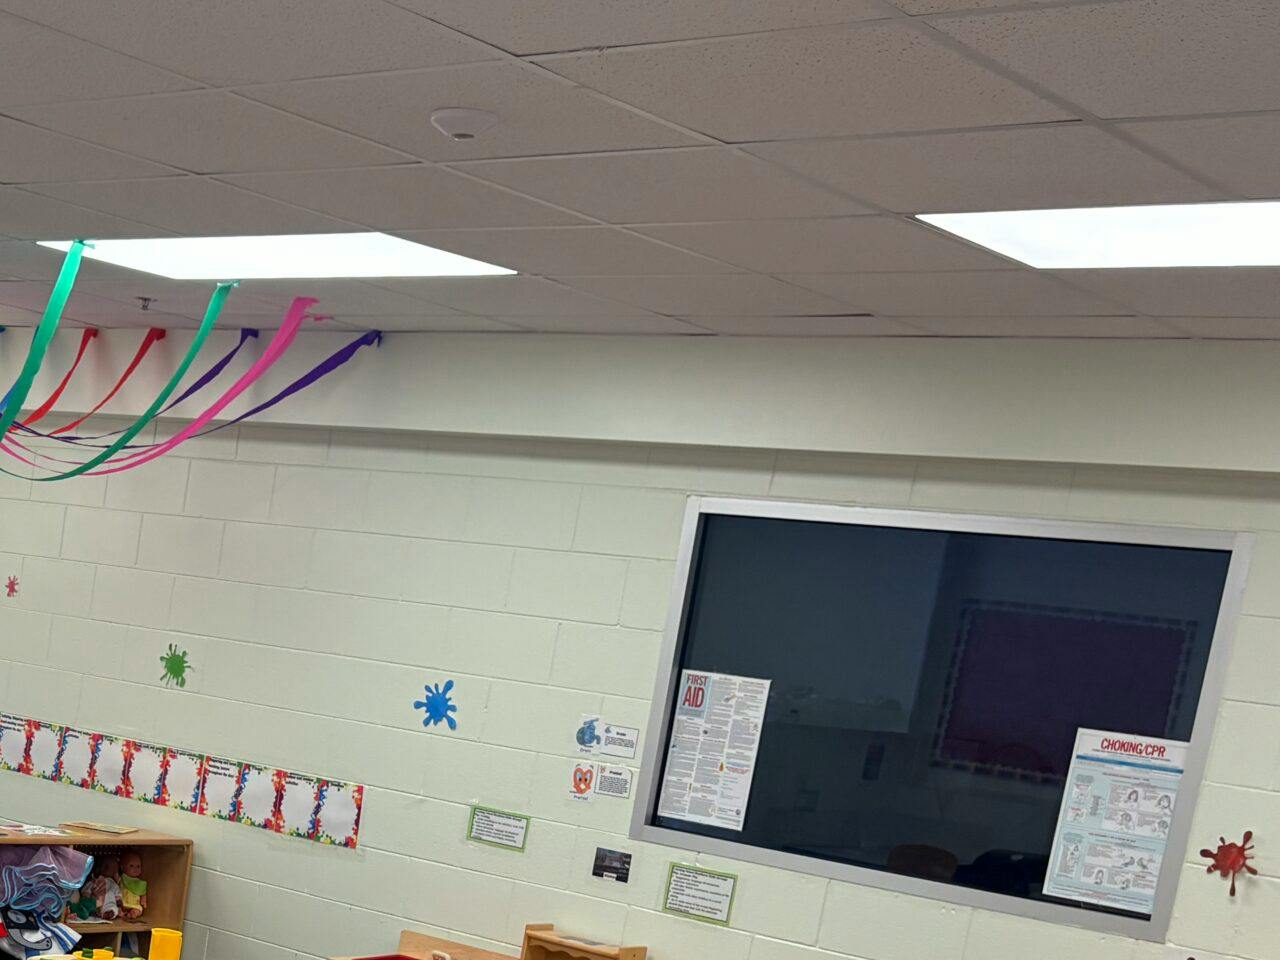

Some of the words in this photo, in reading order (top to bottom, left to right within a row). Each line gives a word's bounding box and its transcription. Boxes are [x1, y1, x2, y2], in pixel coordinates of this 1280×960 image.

[686, 673, 709, 687] FIRST
[682, 685, 706, 708] AID
[1100, 737, 1167, 758] CHOKING/CPR
